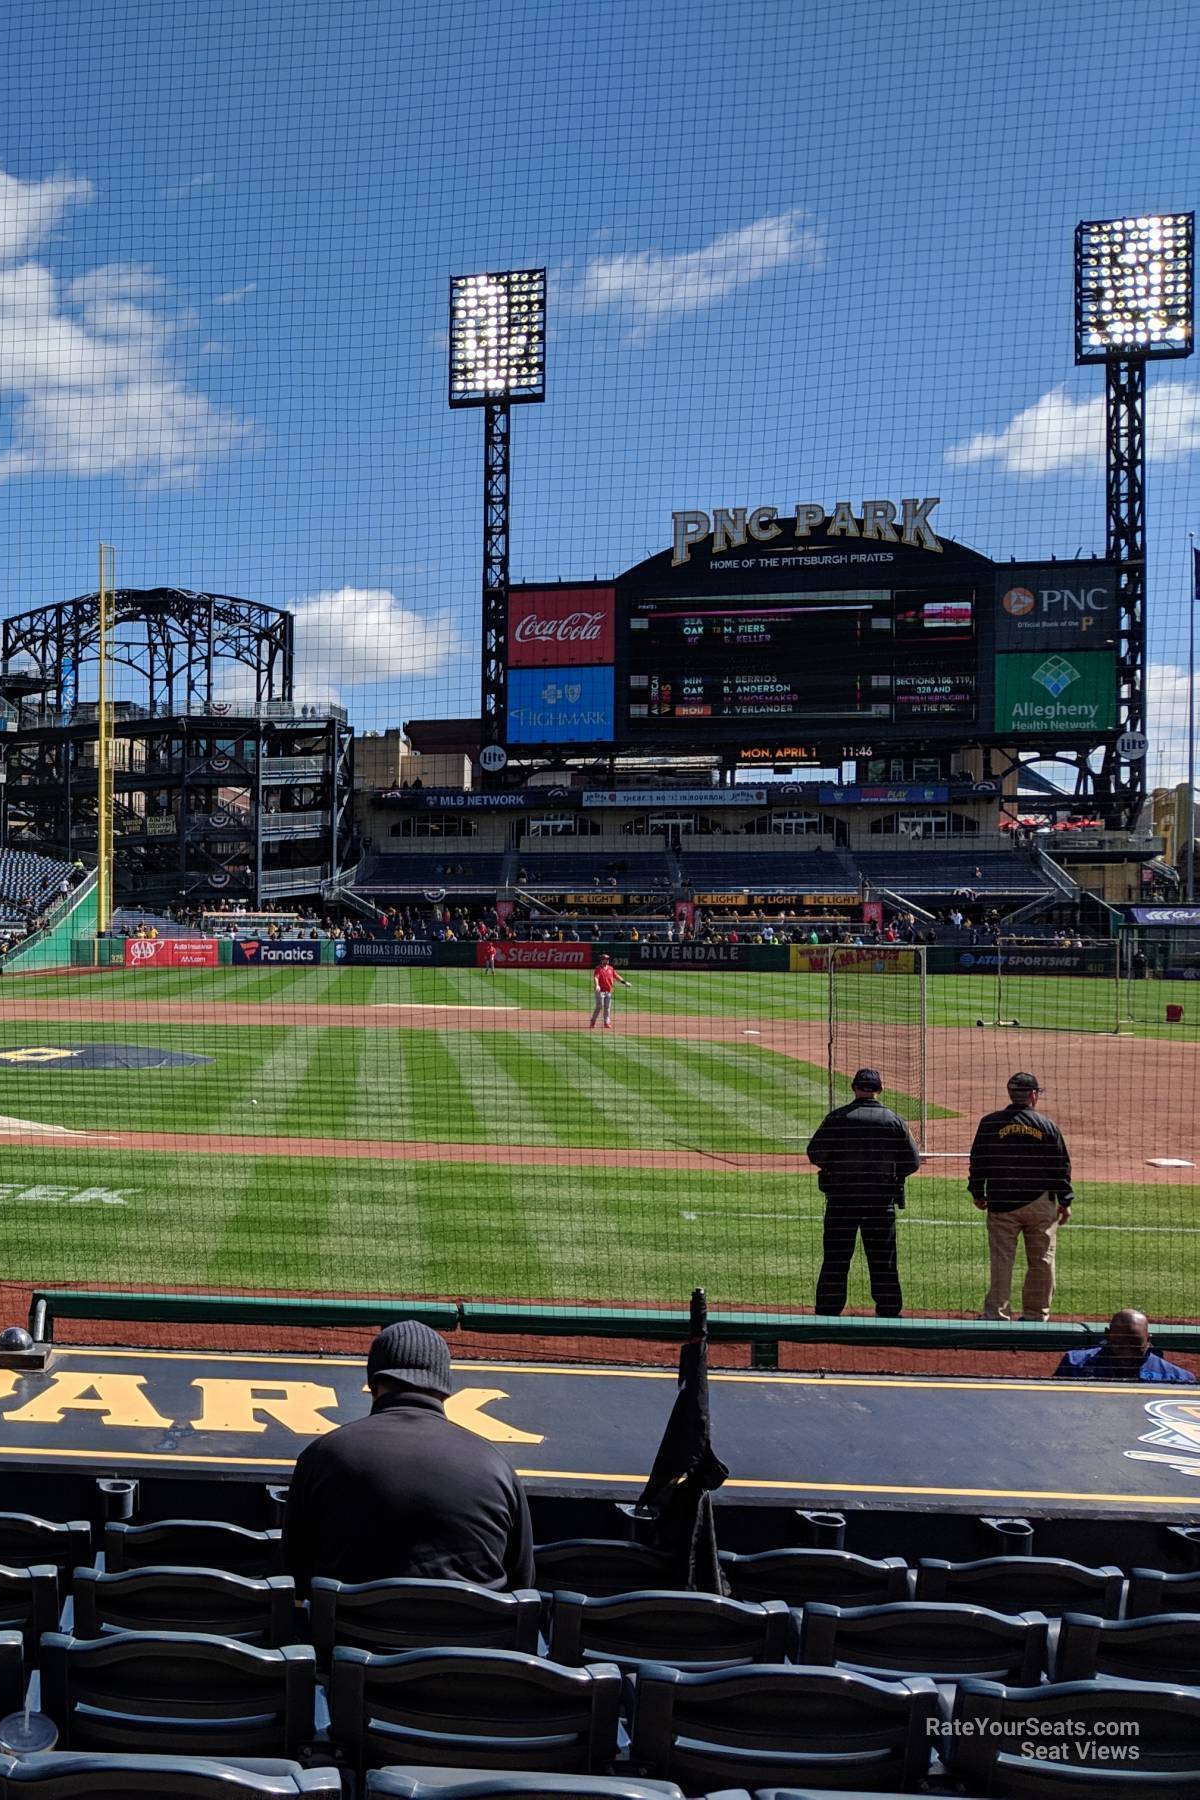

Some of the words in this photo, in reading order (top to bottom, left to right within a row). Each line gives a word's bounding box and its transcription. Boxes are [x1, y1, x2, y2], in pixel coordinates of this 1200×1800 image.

[671, 506, 783, 567] PNC
[795, 497, 944, 553] PARK
[709, 558, 740, 570] HOME
[742, 558, 757, 568] OF
[759, 557, 780, 568] THE
[781, 554, 848, 567] PITTSBURGH
[850, 552, 894, 564] PIRATES
[1040, 588, 1109, 612] PNC
[683, 626, 704, 635] OAK
[723, 626, 735, 634] M.
[738, 624, 766, 634] FIERS
[1060, 620, 1067, 628] of
[1081, 616, 1094, 631] P
[736, 634, 772, 644] KELLER
[896, 677, 936, 687] SECTIONS
[683, 686, 704, 695] OAK
[723, 685, 733, 694] B.
[735, 683, 791, 694] ANDERSON
[933, 685, 951, 694] AND
[682, 706, 704, 715] HOU
[723, 705, 732, 714] J.
[735, 703, 793, 714] VERLANDER
[923, 703, 939, 712] THE
[1011, 702, 1099, 719] Allegheny
[511, 708, 608, 727] HIGHMARK
[1011, 720, 1048, 730] Health
[1050, 719, 1097, 730] Network
[1119, 738, 1146, 753] Lite
[741, 748, 773, 759] MON,
[775, 747, 808, 758] APRIL
[811, 747, 817, 757] 1
[842, 746, 873, 757] 11:46
[482, 752, 504, 766] Lite
[440, 795, 465, 807] MLB
[467, 794, 525, 807] NETWORK
[587, 895, 614, 904] LIGHT
[697, 895, 708, 904] IC
[711, 895, 741, 904] LIGHT
[753, 895, 766, 904] IC
[768, 895, 798, 905] LIGHT
[813, 895, 825, 904] IC
[827, 895, 856, 905] LIGHT
[133, 942, 153, 957] AAA
[260, 945, 314, 961] Fanatics
[353, 944, 390, 955] BORDAS
[394, 944, 432, 956] BORDAS
[640, 945, 740, 960] RIVENDALE
[1008, 956, 1081, 967] SPORTSNET
[999, 1123, 1043, 1140] SUPERVISOR
